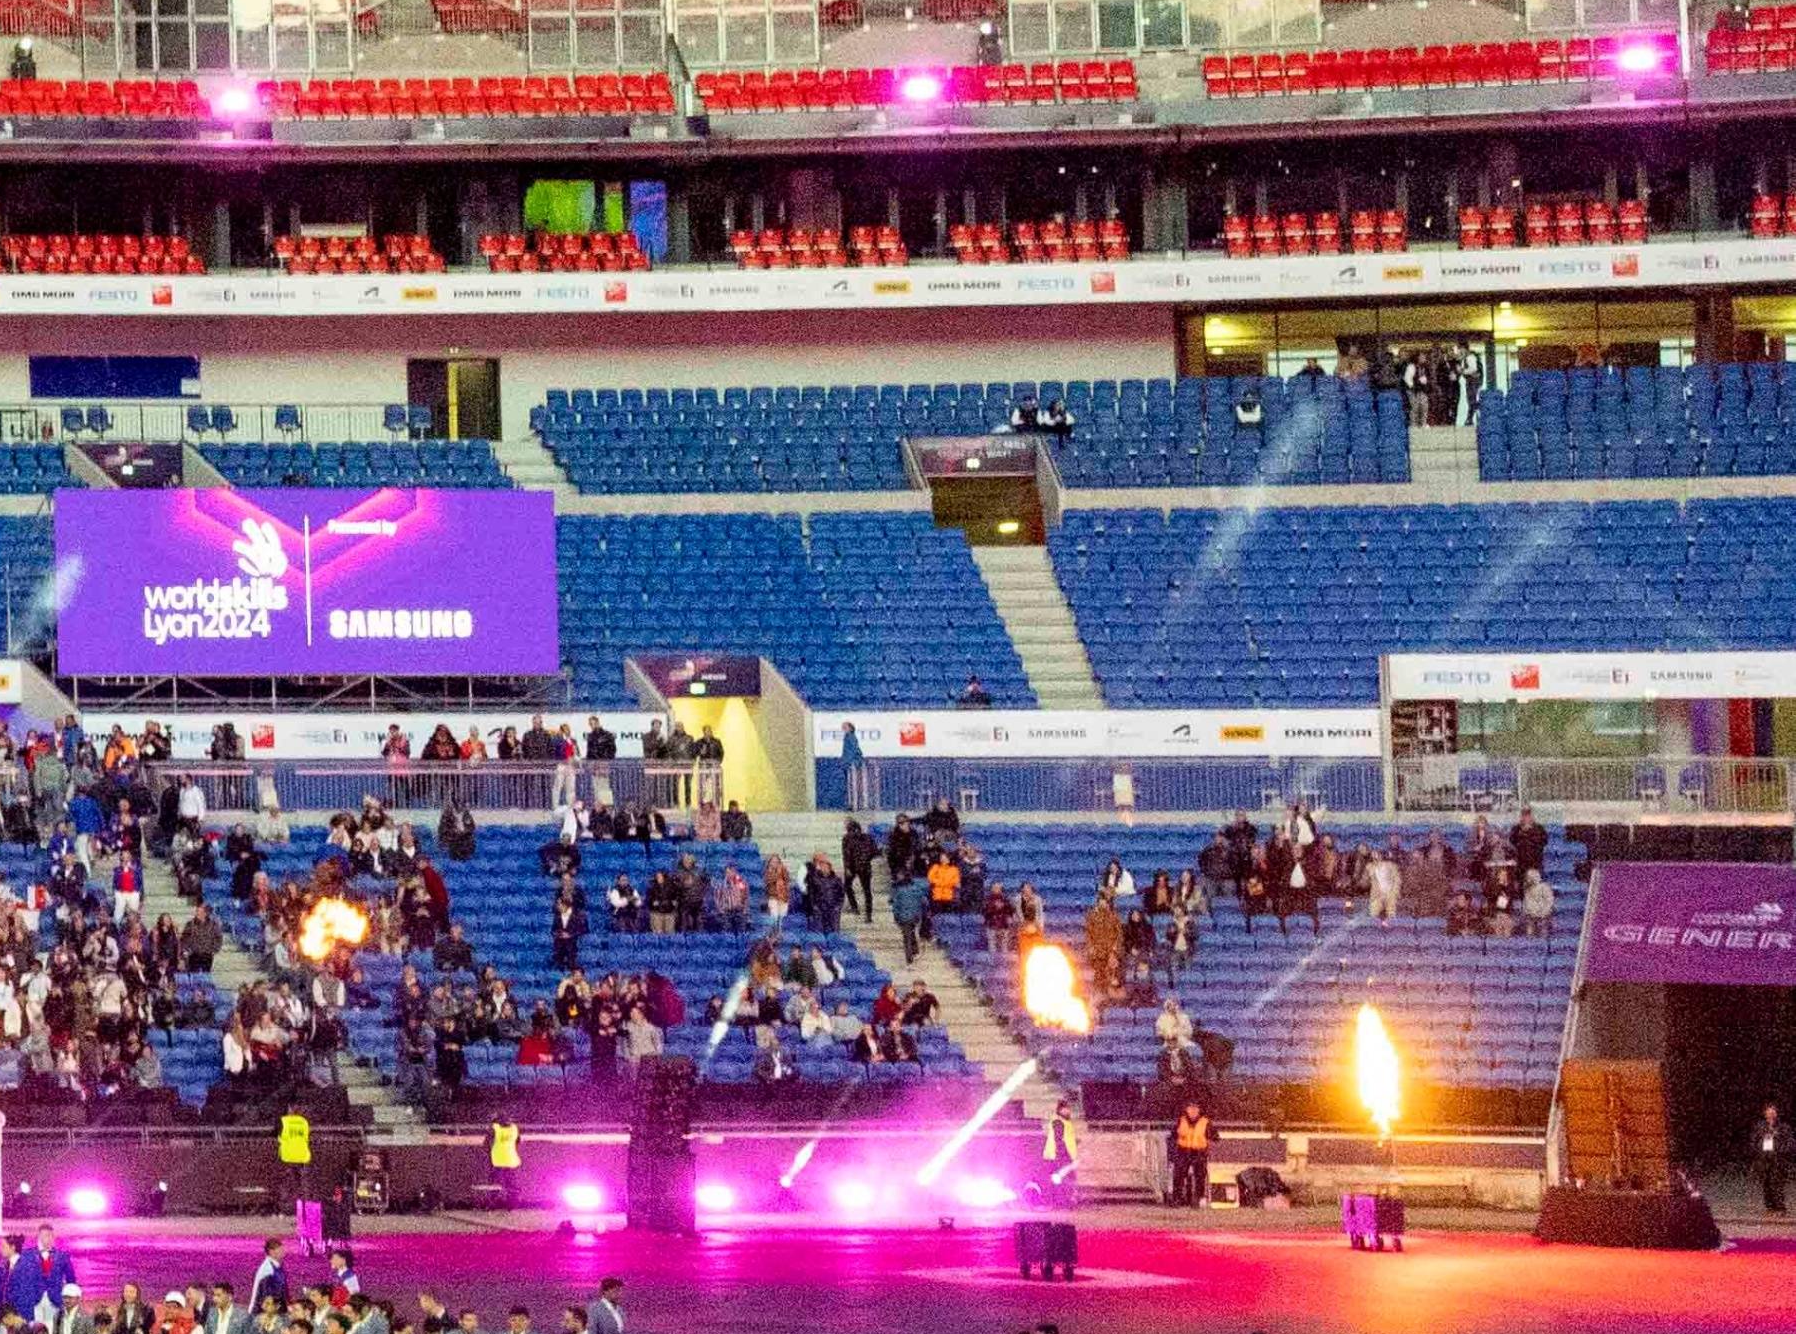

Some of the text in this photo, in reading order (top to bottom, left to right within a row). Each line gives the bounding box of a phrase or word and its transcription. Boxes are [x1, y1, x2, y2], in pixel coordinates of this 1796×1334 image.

[144, 578, 288, 610] worldskills
[143, 608, 270, 645] Lyon2024
[328, 610, 472, 639] SAMSUNG
[1284, 729, 1373, 739] DMG MORI
